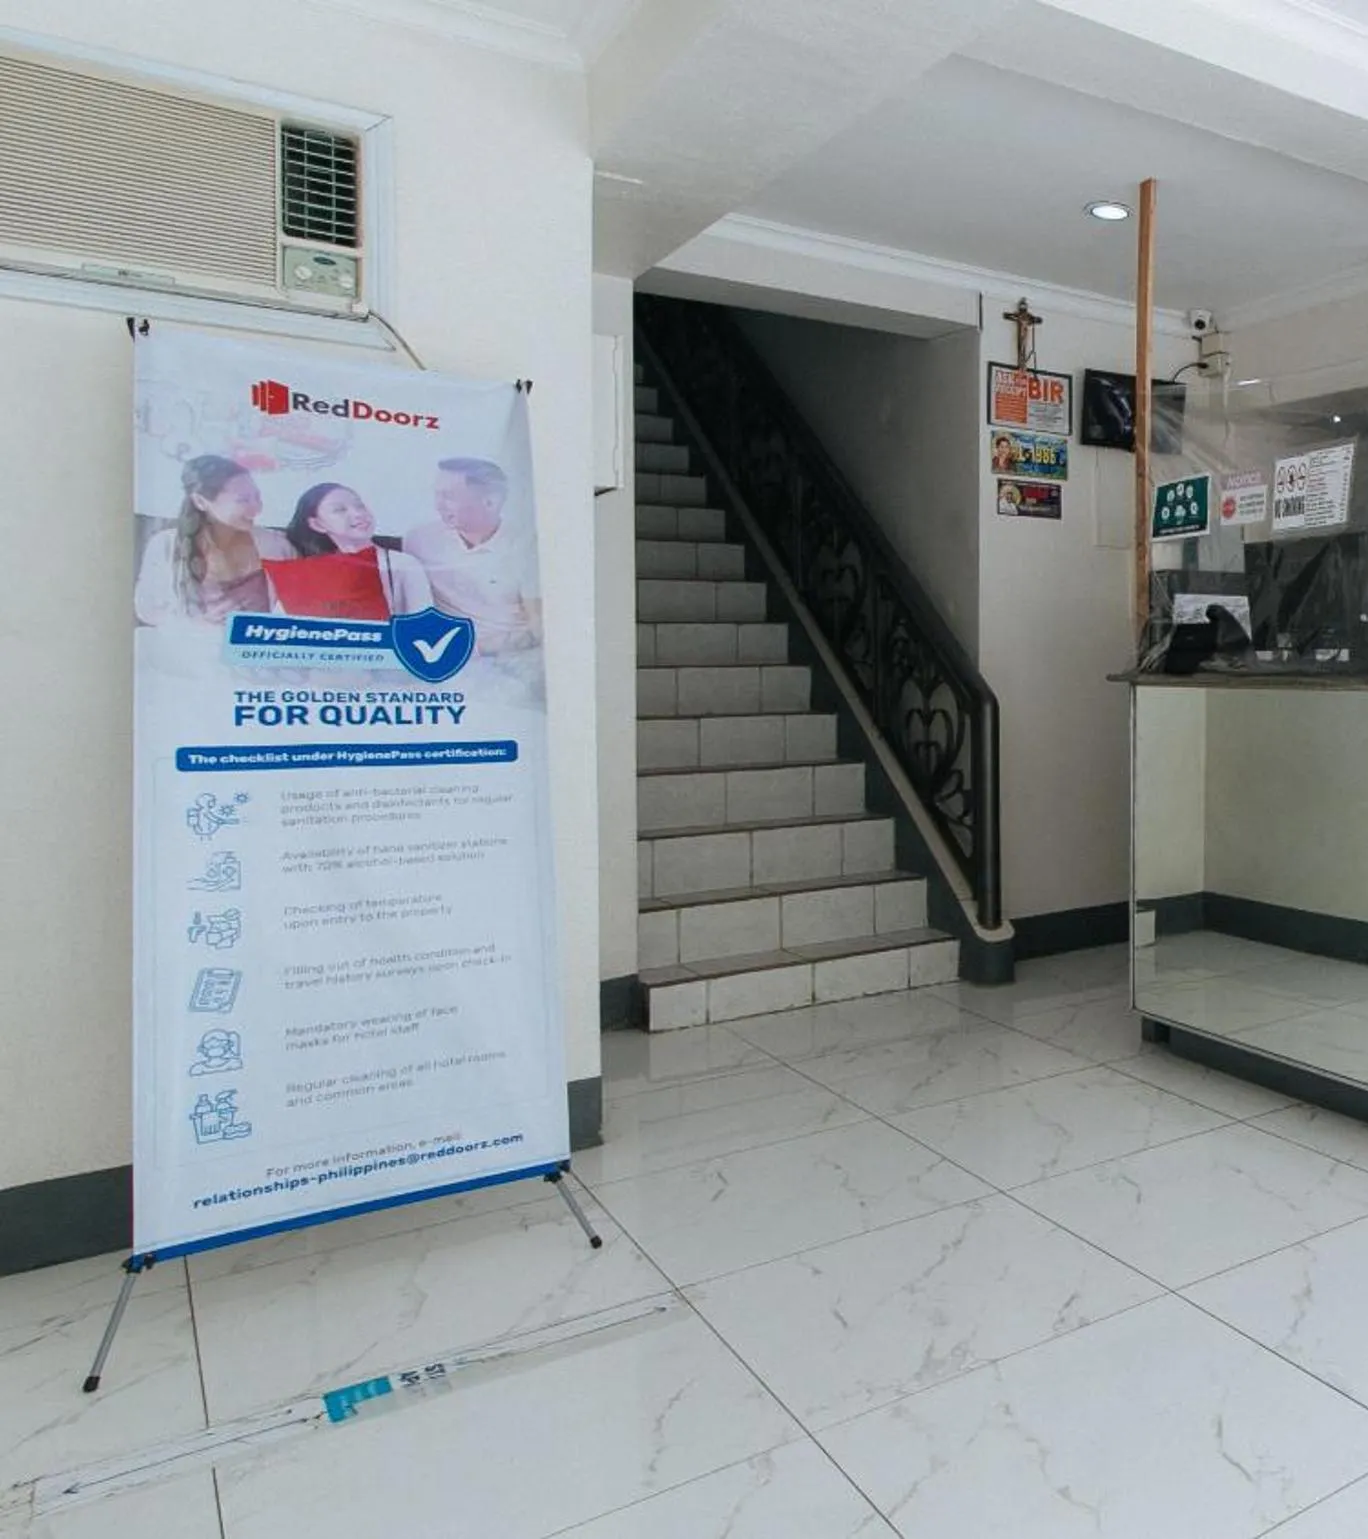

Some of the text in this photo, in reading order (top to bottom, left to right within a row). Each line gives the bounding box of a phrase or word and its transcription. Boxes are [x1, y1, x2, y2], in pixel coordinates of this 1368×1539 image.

[1028, 377, 1064, 404] BIR
[292, 391, 440, 430] RedDoorz
[245, 624, 383, 643] HygienePass
[241, 650, 384, 662] OFFICIALLY CERTIFIED
[234, 690, 464, 704] THE GOLDEN STANDARD
[234, 704, 467, 727] FOR QUALITY
[188, 753, 217, 765] The
[223, 752, 290, 764] checklist
[292, 750, 334, 763] under
[336, 749, 422, 763] HygienePass
[266, 1165, 289, 1178] For
[293, 1158, 329, 1175] more
[332, 1139, 417, 1164] information,
[193, 1132, 524, 1209] relationships-philippines@reddoorz.com
